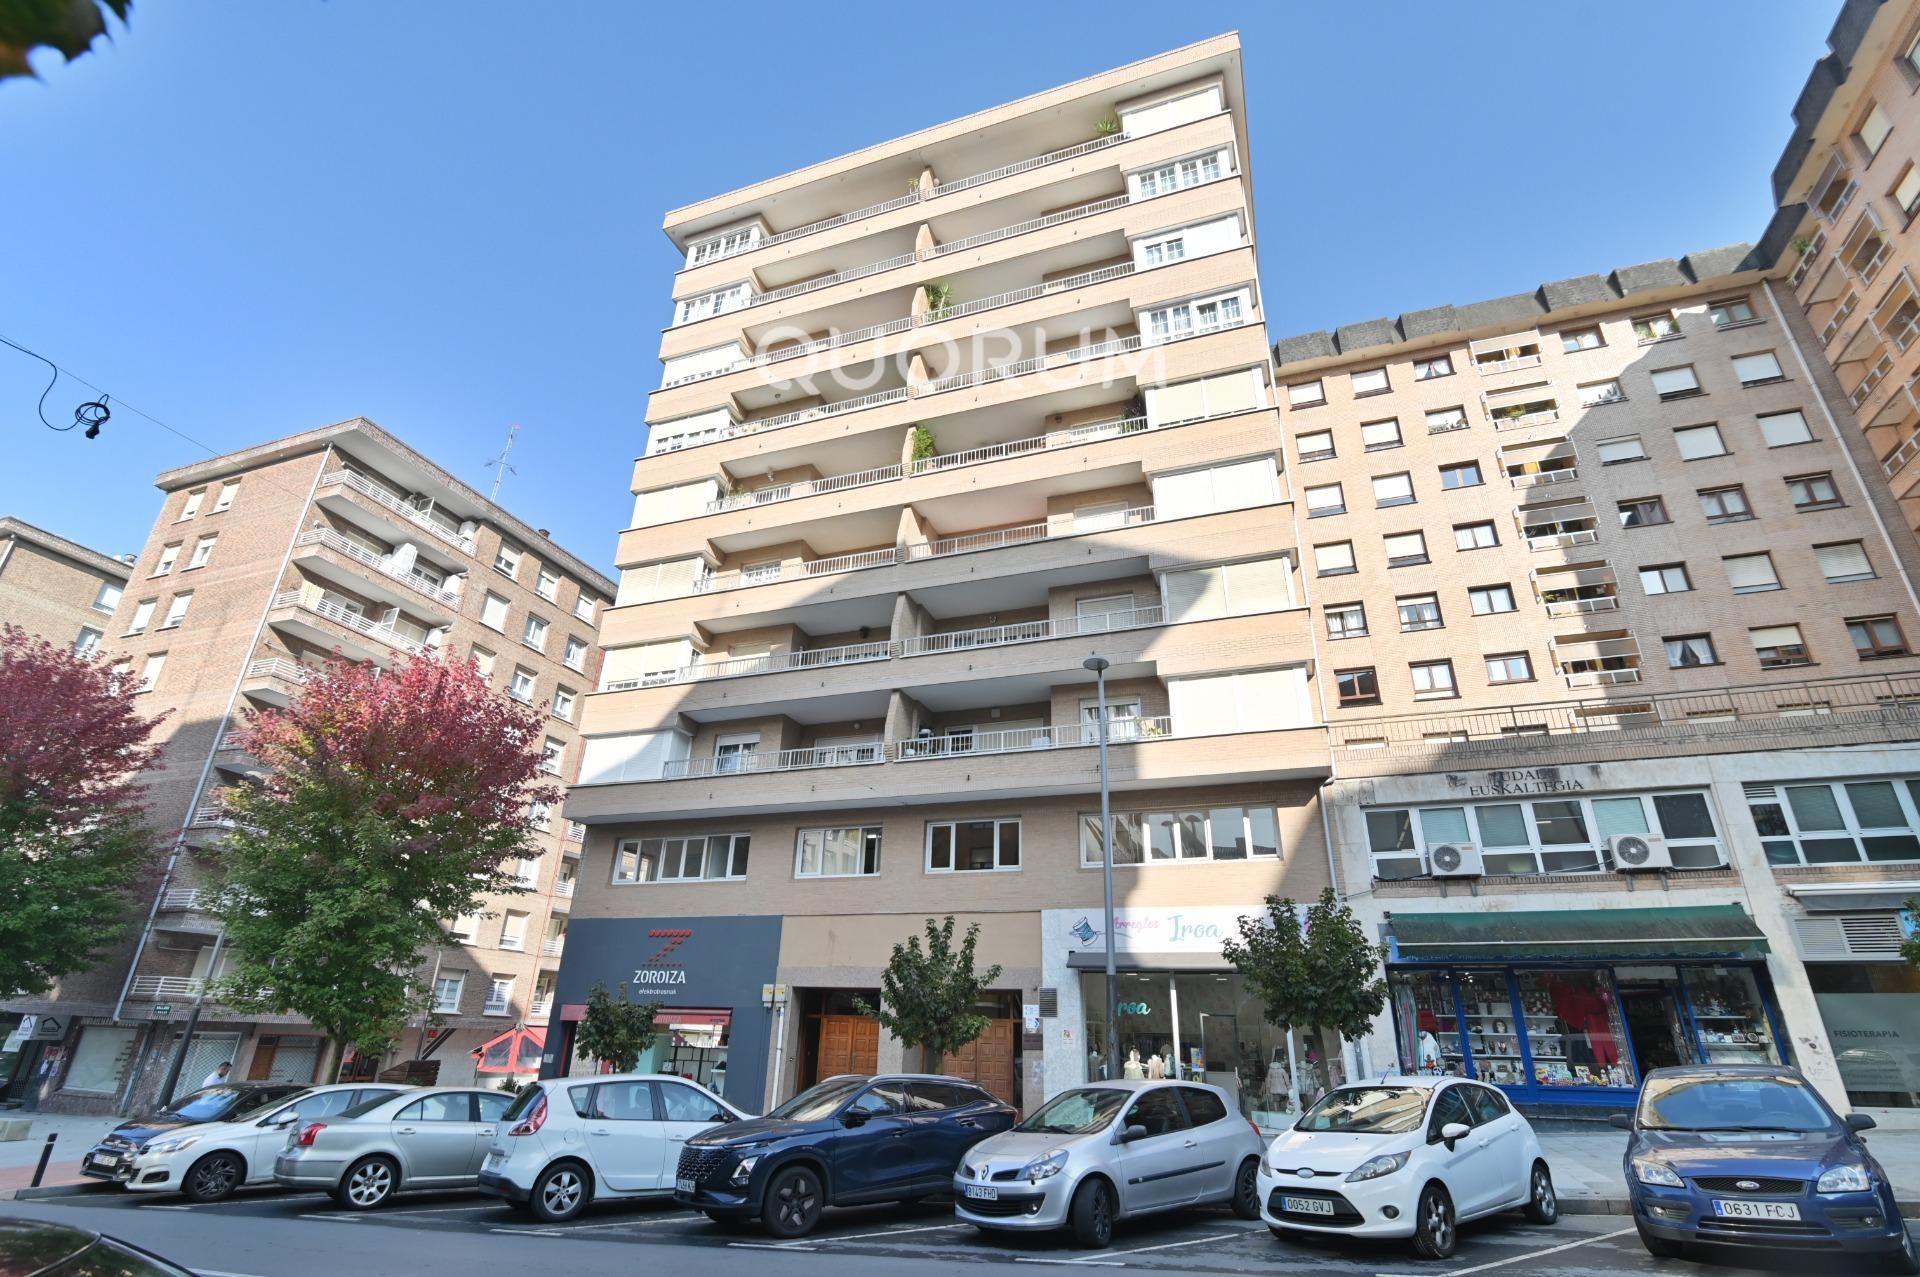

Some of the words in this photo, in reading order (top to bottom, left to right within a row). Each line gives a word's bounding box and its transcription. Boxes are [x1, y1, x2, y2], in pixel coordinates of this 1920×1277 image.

[1470, 779, 1584, 796] EUSKALTEGIA
[1168, 914, 1223, 942] Iroa
[633, 970, 686, 984] ZOROIZA
[1117, 1002, 1151, 1016] roa
[1833, 1030, 1900, 1038] FISIOTERAPIA
[1287, 1198, 1310, 1211] 0052
[1312, 1201, 1332, 1213] GVJ
[1723, 1202, 1761, 1216] 0631
[1765, 1204, 1796, 1218] FCJ
